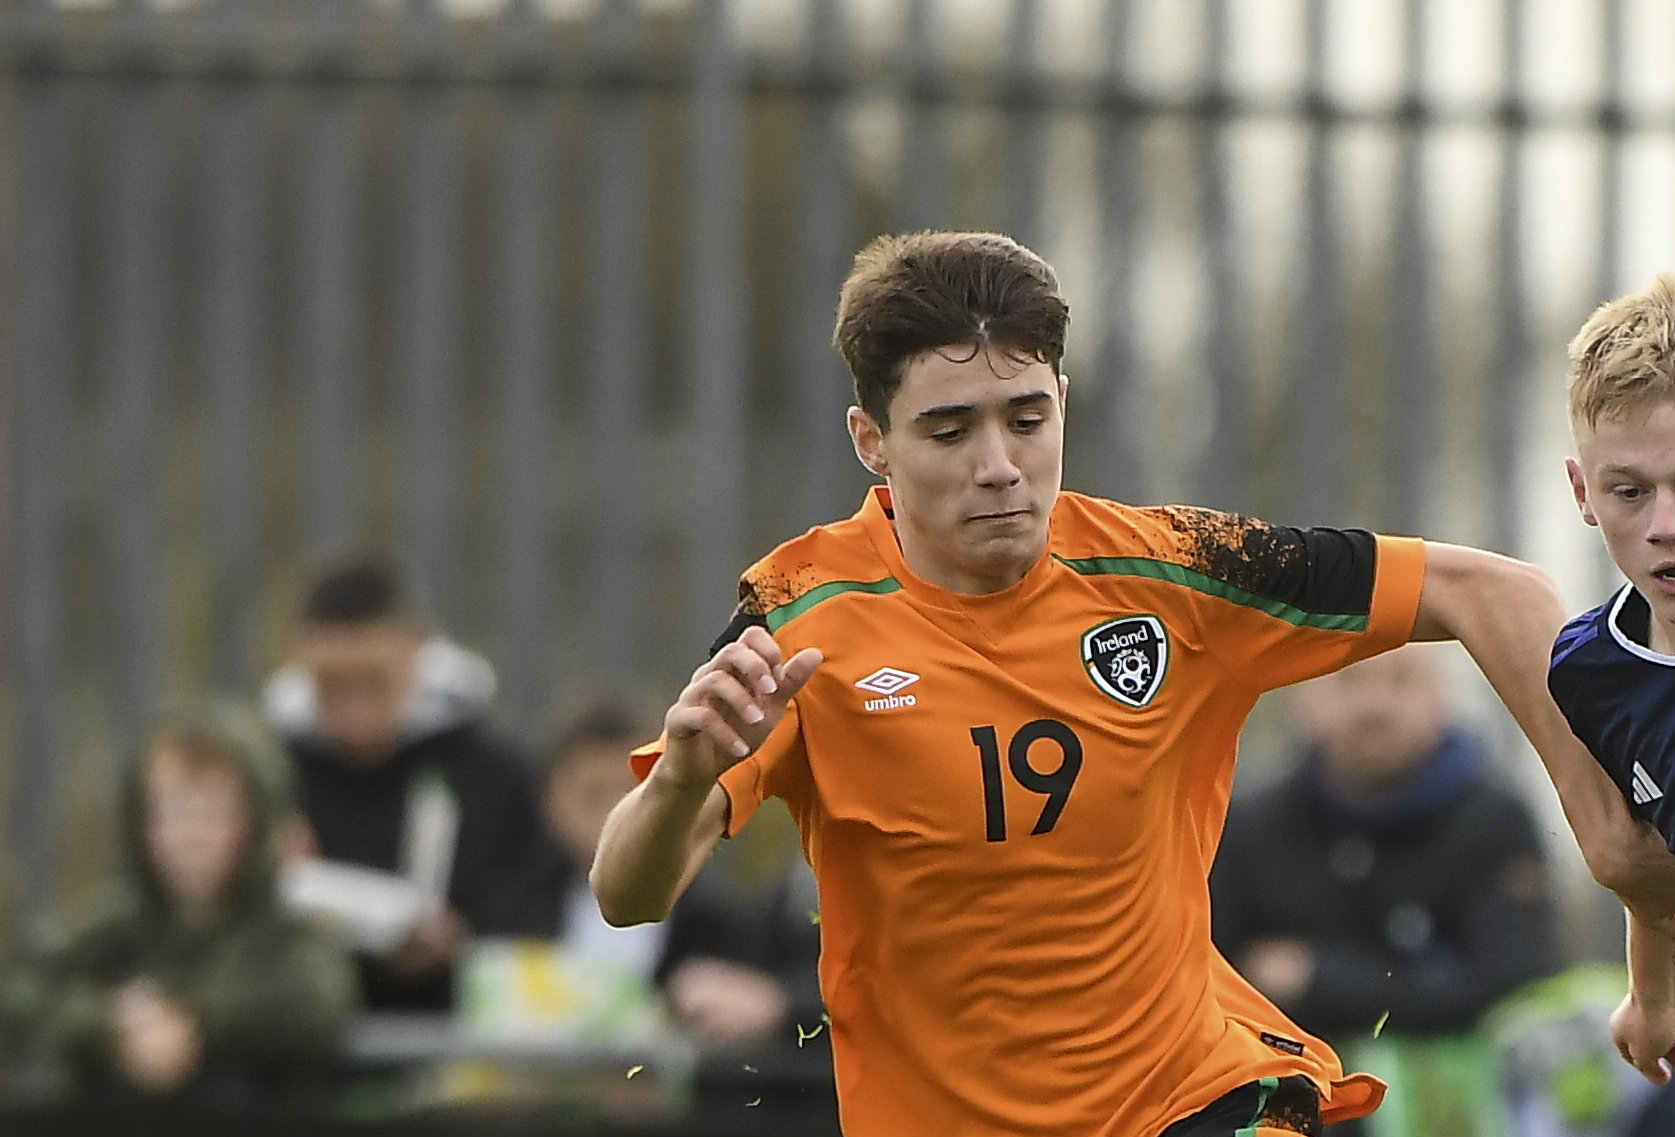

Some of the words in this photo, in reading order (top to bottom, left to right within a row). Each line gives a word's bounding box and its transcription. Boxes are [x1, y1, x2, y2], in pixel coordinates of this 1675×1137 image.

[1094, 625, 1148, 654] Ireland
[865, 695, 916, 711] umbro
[970, 719, 1083, 842] 19
